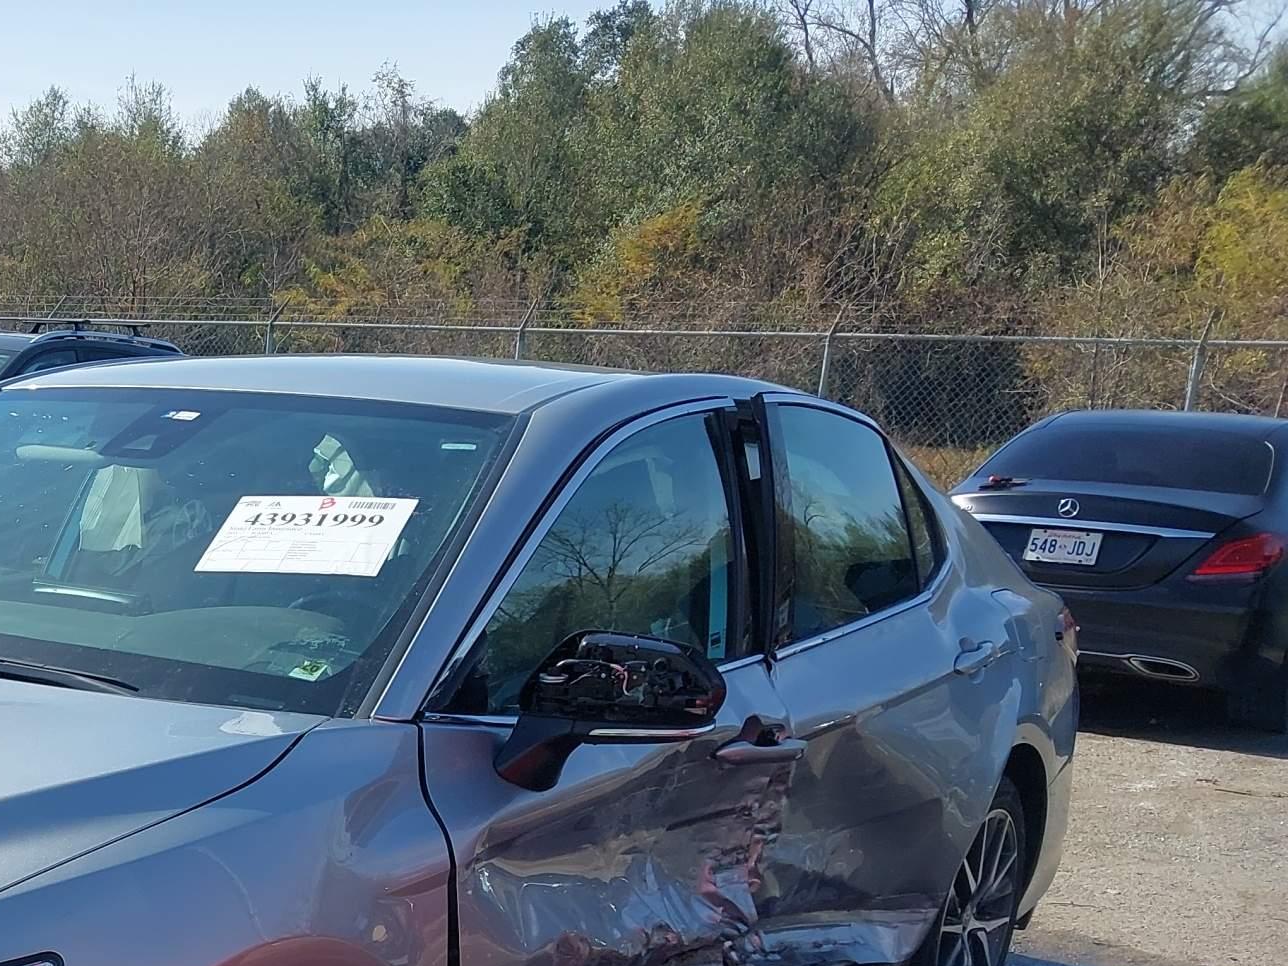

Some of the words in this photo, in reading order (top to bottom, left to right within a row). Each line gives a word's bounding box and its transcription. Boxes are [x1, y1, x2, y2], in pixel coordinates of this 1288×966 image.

[244, 512, 385, 528] 43931999
[1029, 537, 1058, 554] 548
[1066, 540, 1096, 557] JDJ
